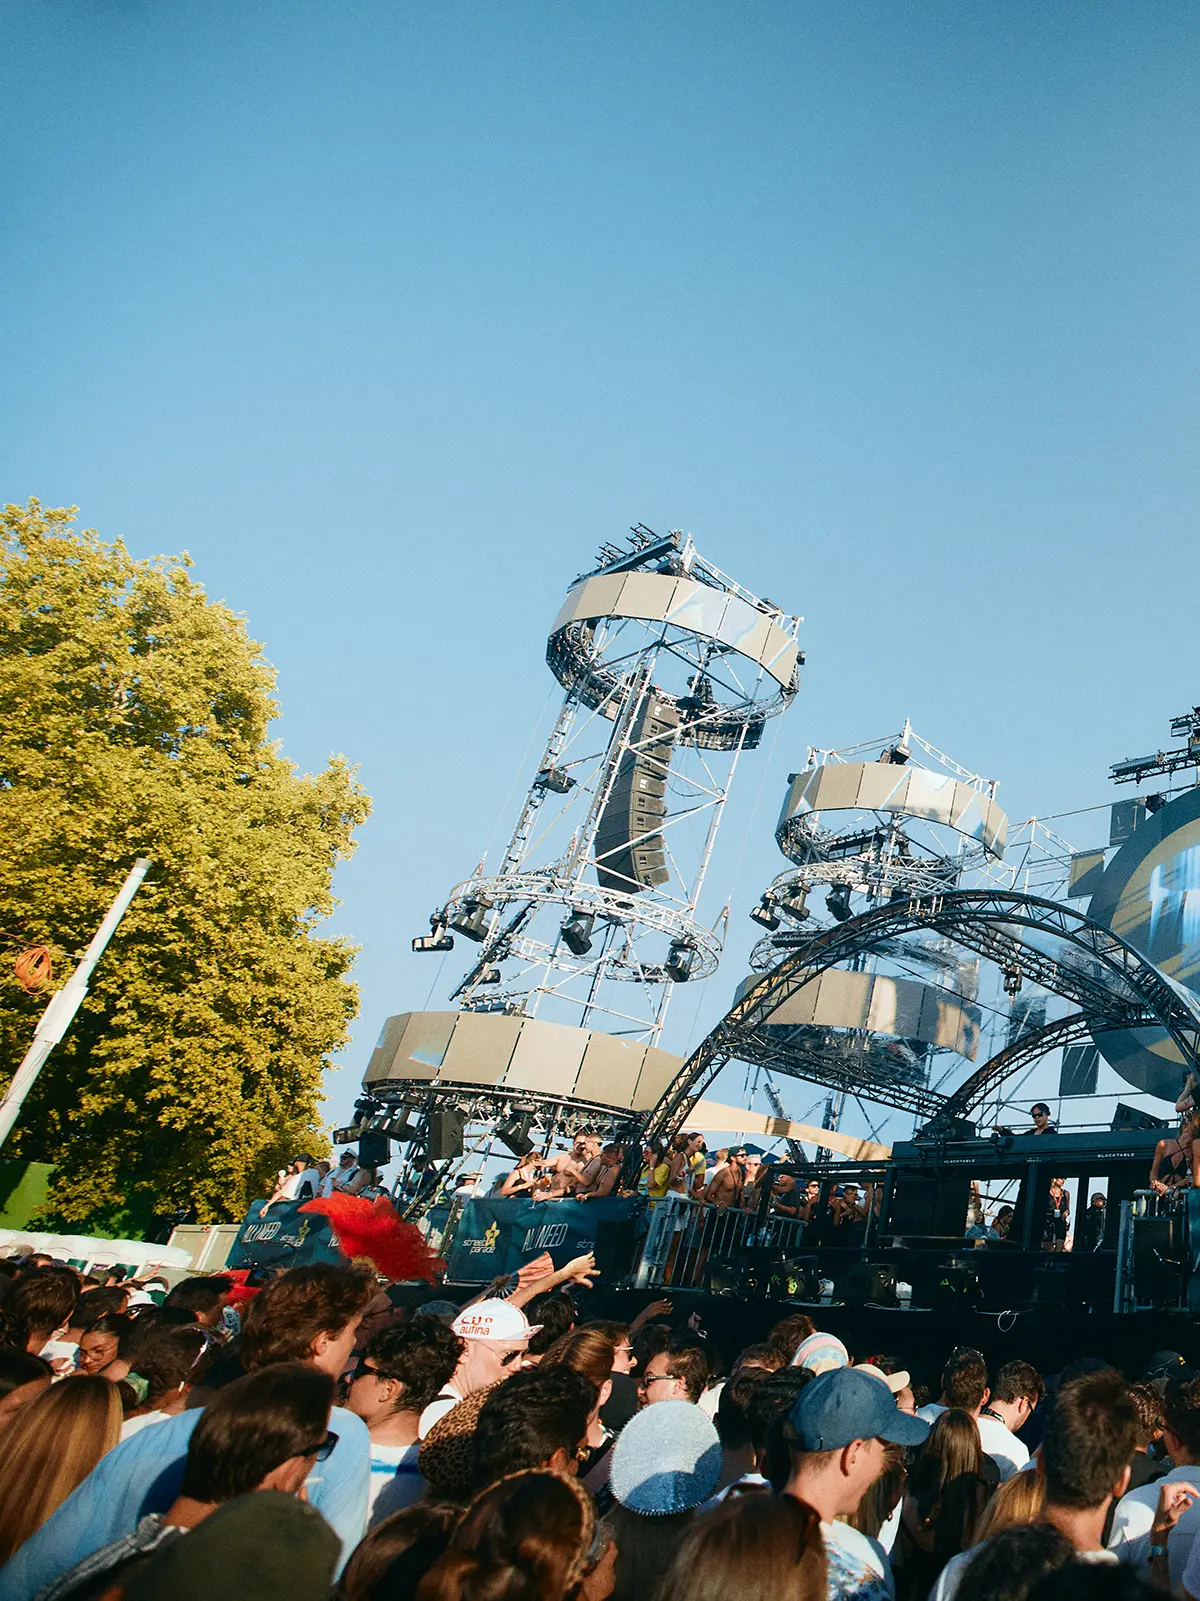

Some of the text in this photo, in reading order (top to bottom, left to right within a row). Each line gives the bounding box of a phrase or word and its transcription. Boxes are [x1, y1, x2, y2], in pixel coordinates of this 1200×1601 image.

[535, 1223, 569, 1248] NEED
[462, 1237, 488, 1247] street
[576, 1238, 595, 1249] stre
[469, 1246, 496, 1255] parade
